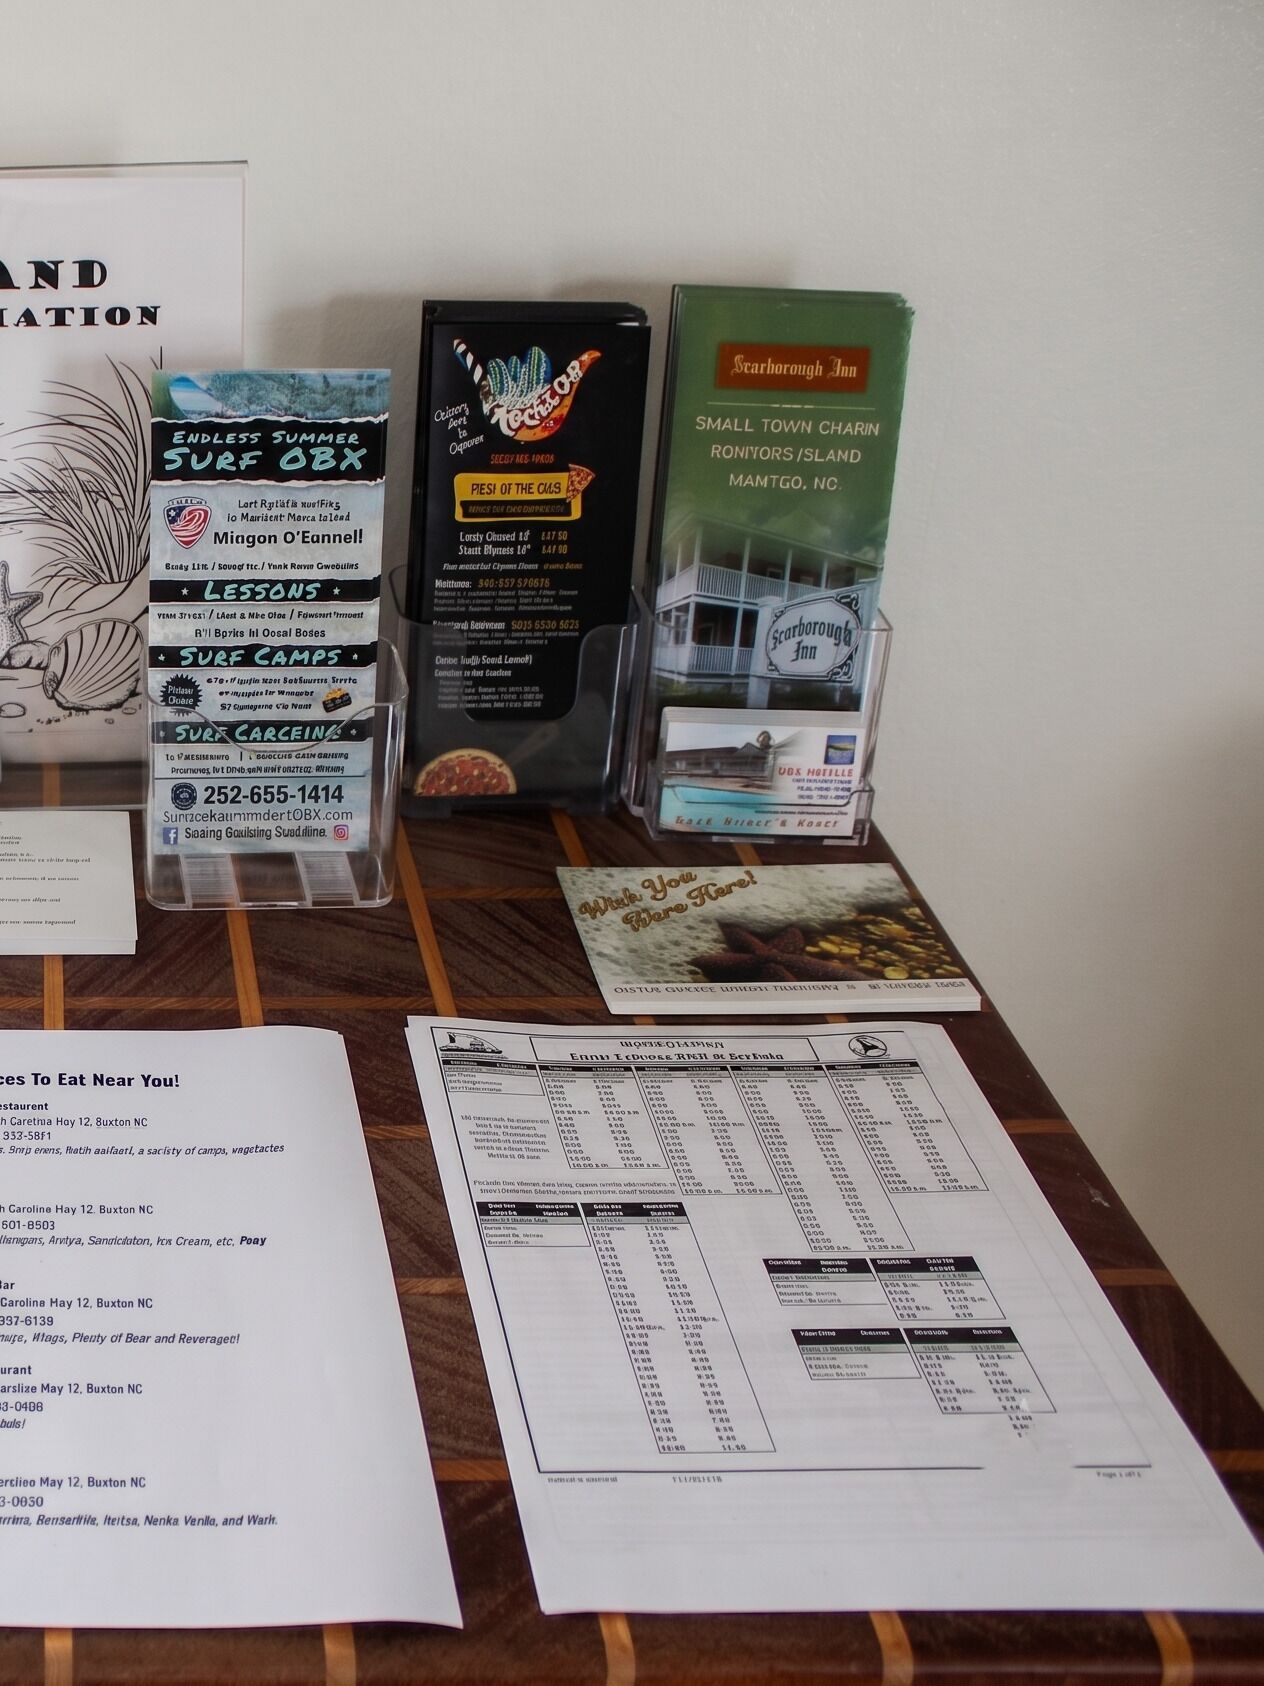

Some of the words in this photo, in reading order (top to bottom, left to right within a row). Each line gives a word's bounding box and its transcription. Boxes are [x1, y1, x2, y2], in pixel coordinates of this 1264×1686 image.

[730, 352, 823, 381] Scarborough
[827, 355, 857, 378] Inn
[695, 416, 755, 432] SMALL
[761, 419, 812, 434] TOWN
[172, 431, 262, 444] ENDLESS
[272, 430, 360, 444] SUMMER
[163, 446, 263, 471] SURF
[279, 446, 367, 471] OBX
[515, 483, 534, 495] THE
[204, 581, 321, 600] LESSONS
[771, 616, 852, 651] Scarborough
[180, 647, 245, 666] SURF
[254, 647, 342, 666] CAMPS
[791, 639, 818, 663] Inn
[203, 784, 345, 805] 252-655-1414
[641, 871, 697, 901] You
[686, 870, 758, 908] Here!
[31, 1072, 51, 1086] To
[58, 1073, 86, 1086] Eat
[92, 1073, 134, 1087] Near
[140, 1074, 180, 1088] You!
[134, 1117, 148, 1127] NC
[99, 1205, 135, 1214] Buxton
[139, 1205, 154, 1215] NC
[97, 1298, 134, 1308] Buxton
[138, 1298, 153, 1308] NC
[155, 1334, 175, 1344] and
[87, 1384, 124, 1394] Buxton
[127, 1384, 143, 1395] NC
[87, 1476, 126, 1488] Buxton
[130, 1477, 146, 1488] NC
[222, 1515, 243, 1526] and
